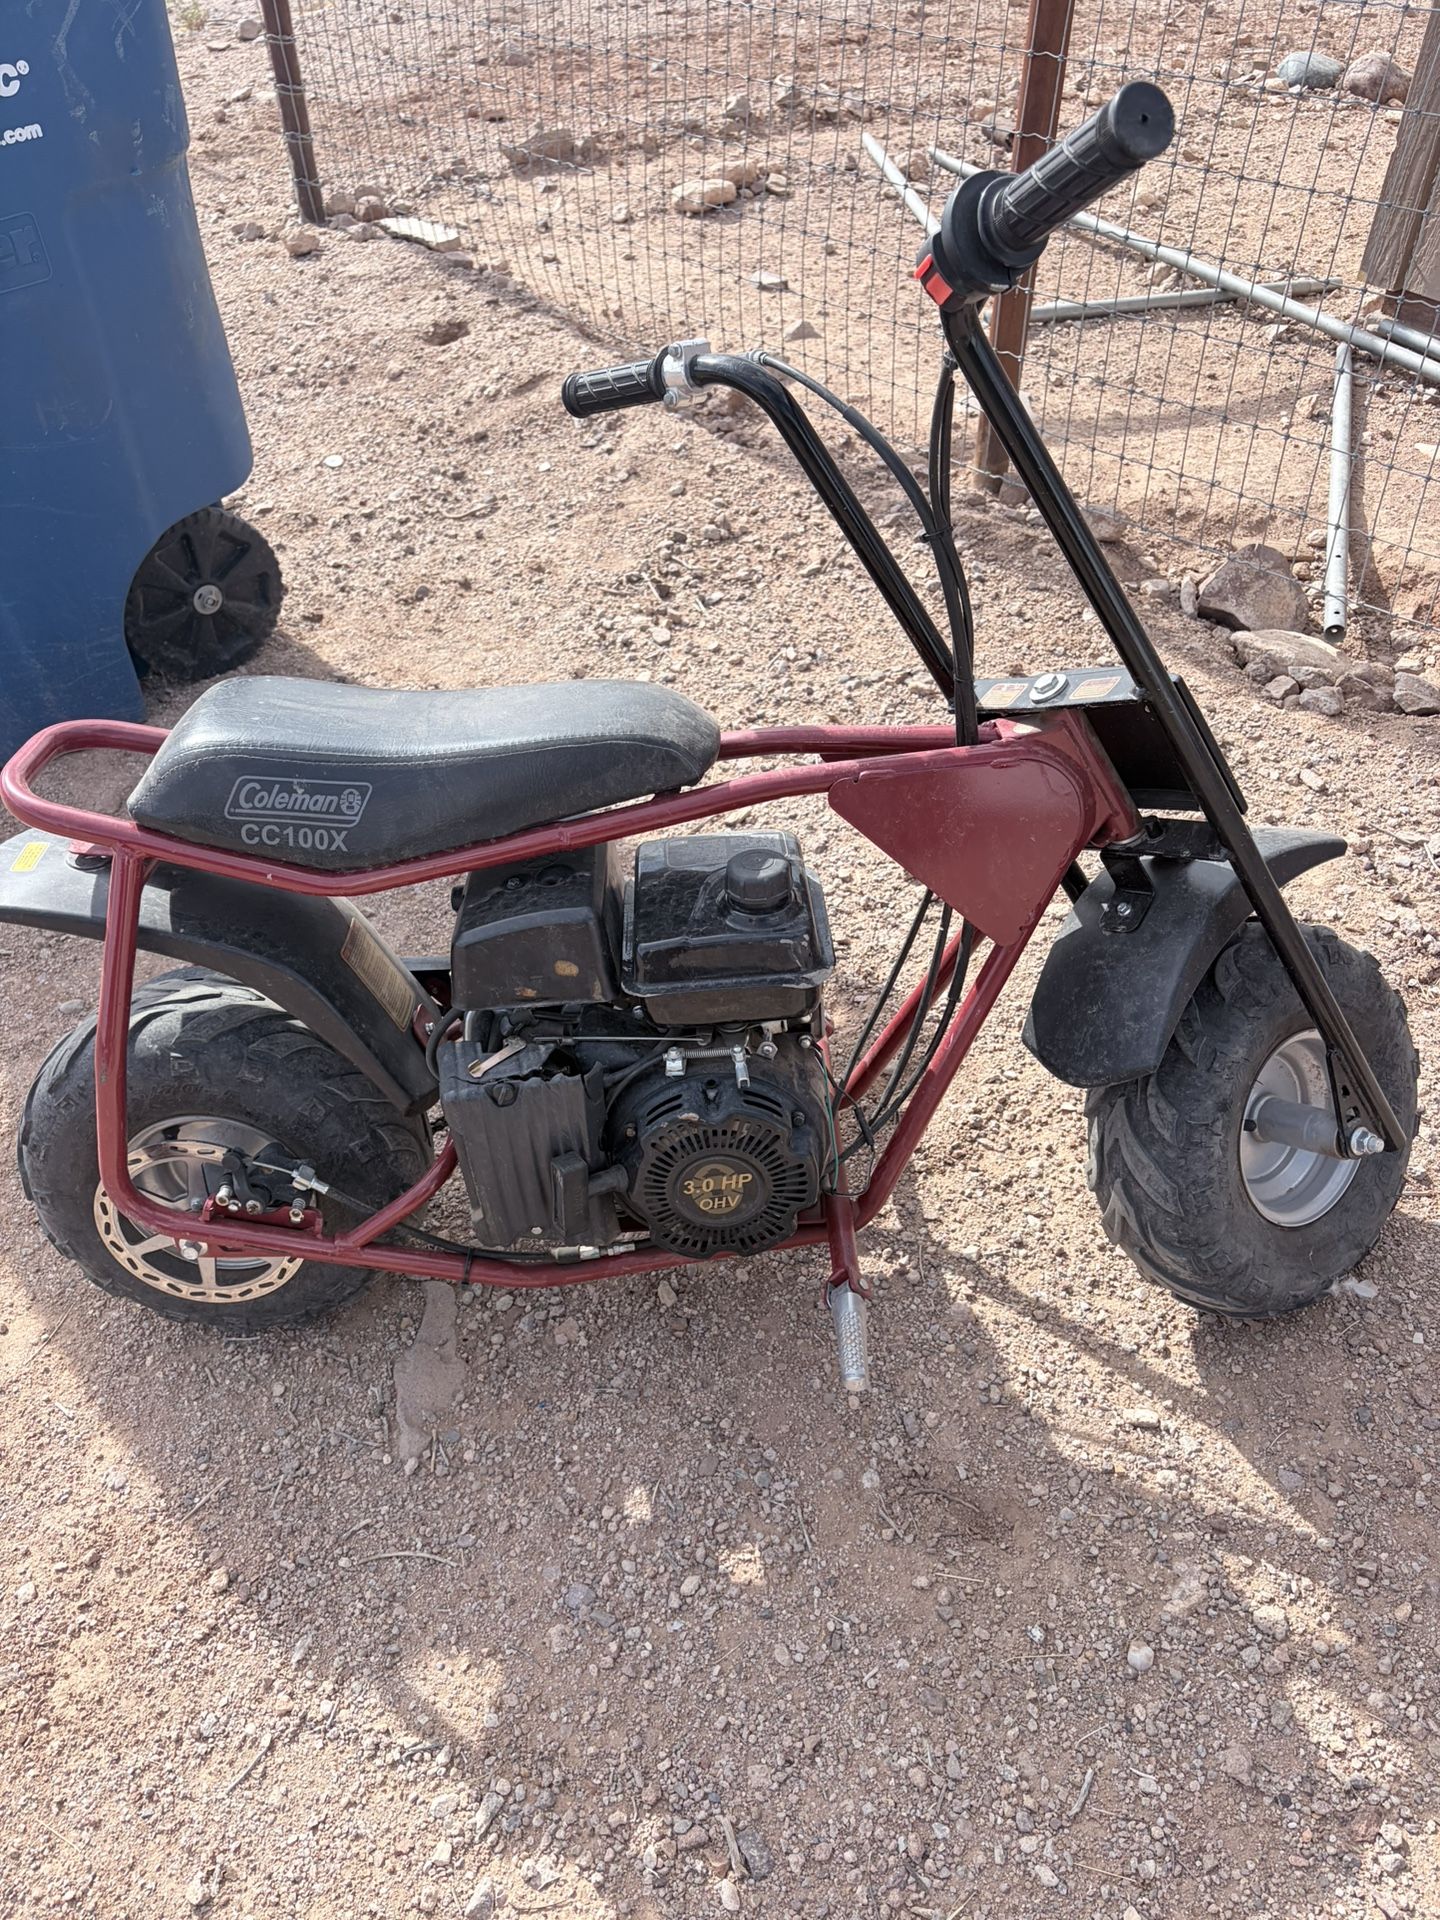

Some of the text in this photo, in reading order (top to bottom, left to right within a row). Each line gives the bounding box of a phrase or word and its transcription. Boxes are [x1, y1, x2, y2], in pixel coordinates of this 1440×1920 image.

[238, 782, 339, 813] Coleman
[240, 823, 349, 852] CC100X
[683, 1172, 753, 1195] 3.0 HP
[699, 1194, 741, 1210] OHV
